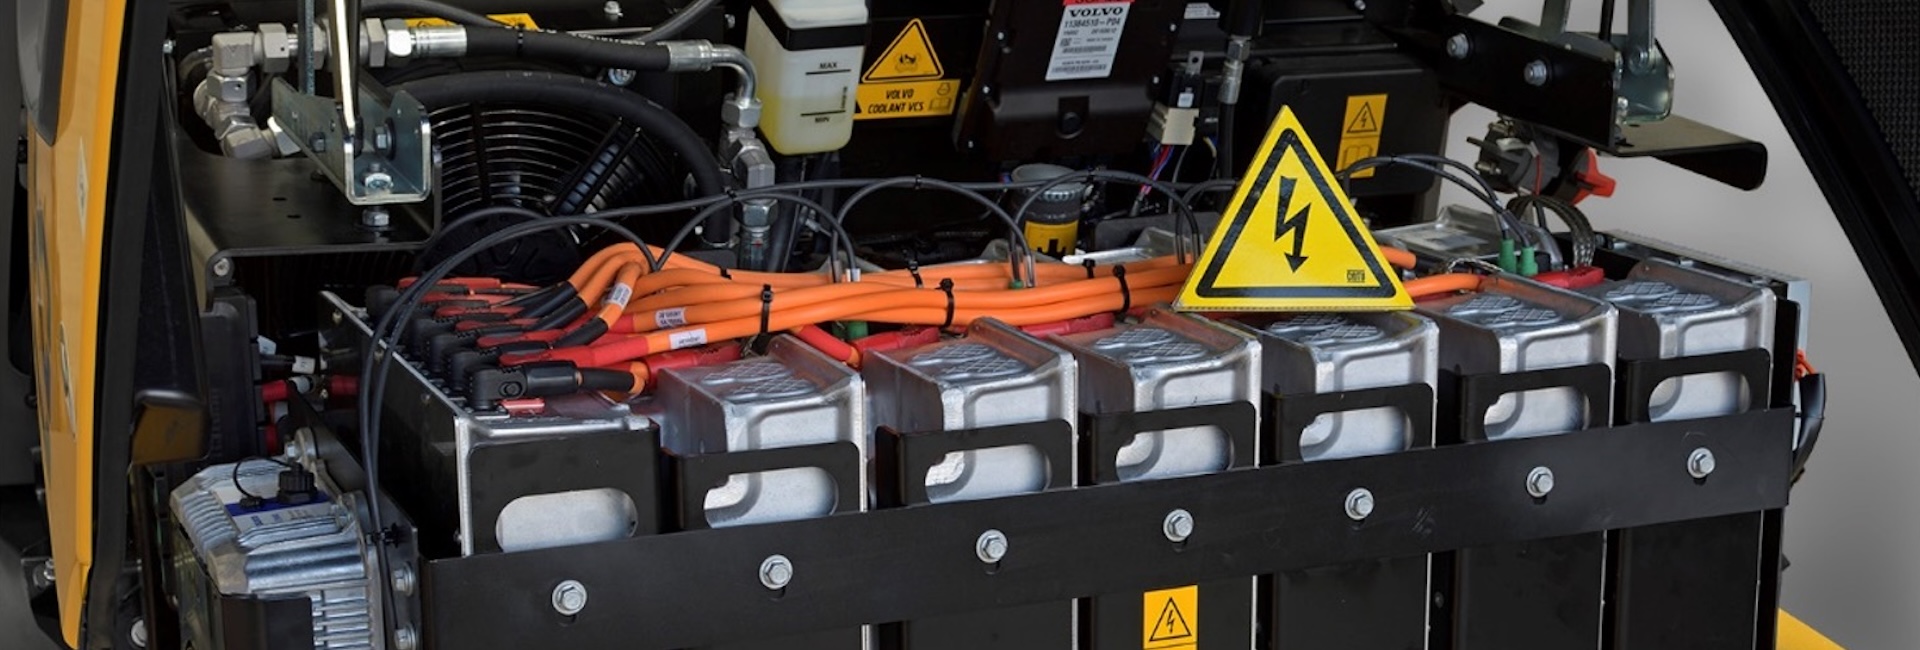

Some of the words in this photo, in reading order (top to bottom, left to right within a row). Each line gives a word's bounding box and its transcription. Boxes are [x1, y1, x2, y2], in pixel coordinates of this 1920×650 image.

[1069, 7, 1124, 17] VOLVO
[886, 88, 915, 99] VOLVO
[868, 102, 906, 114] COOLANT
[908, 101, 925, 112] VCS
